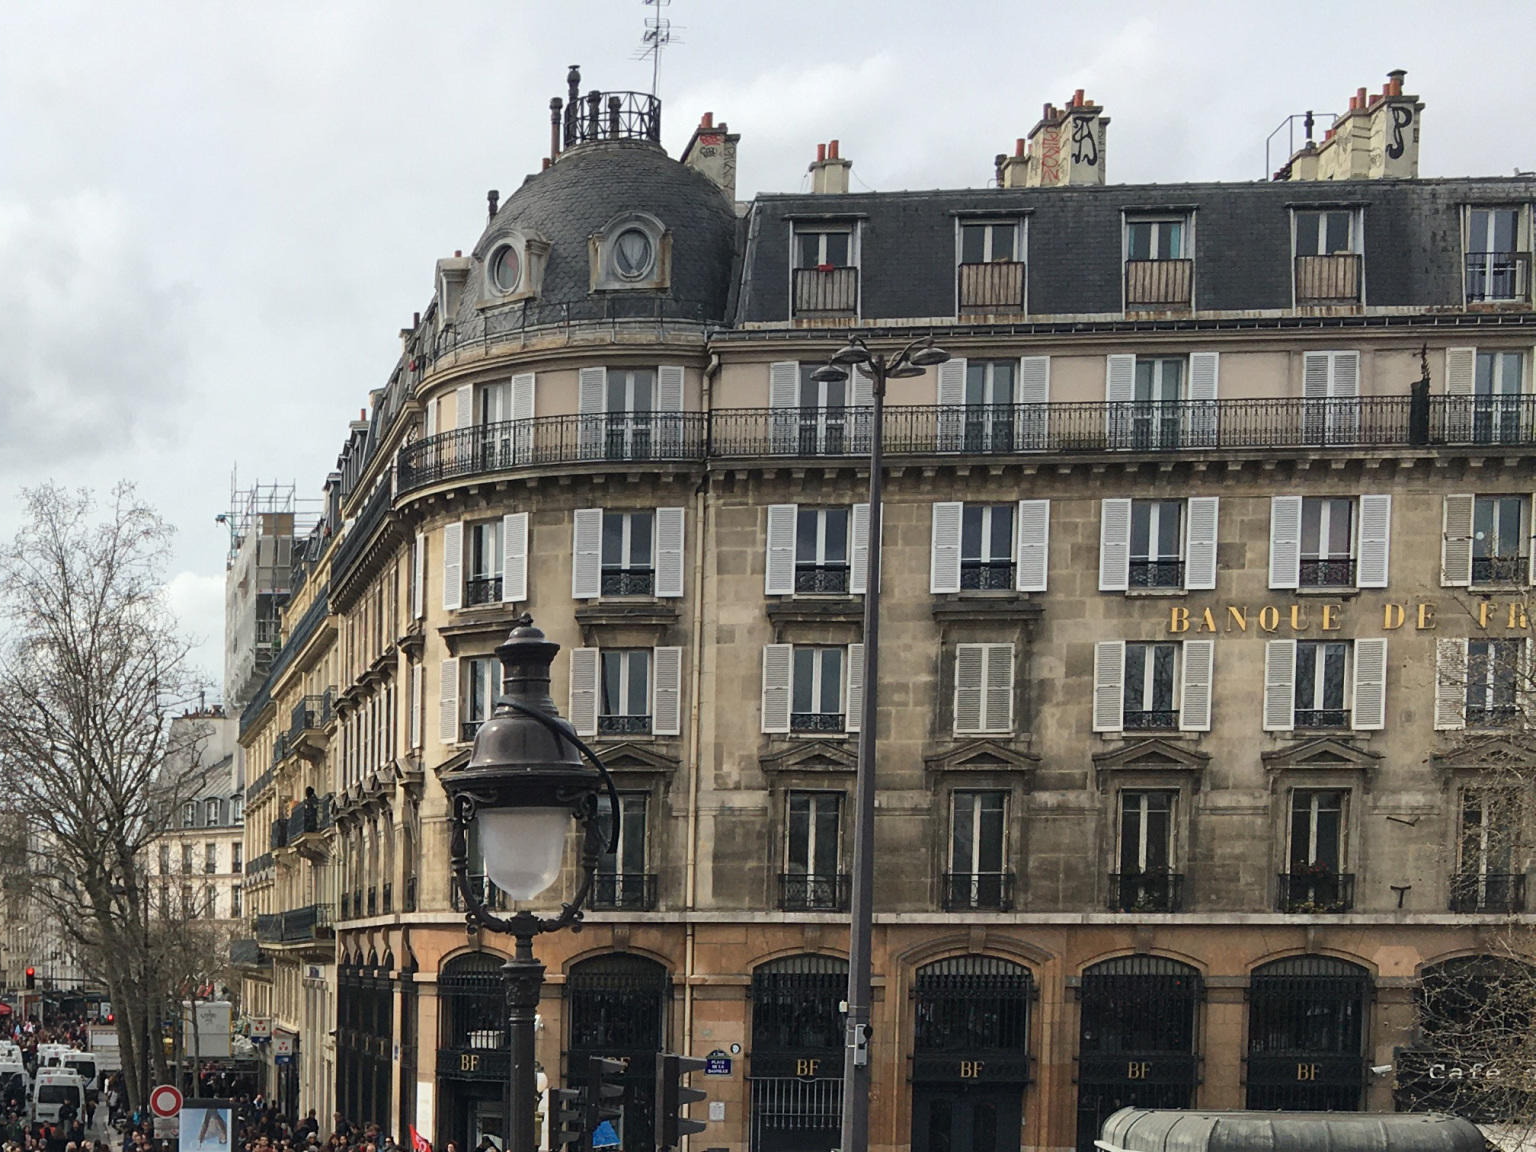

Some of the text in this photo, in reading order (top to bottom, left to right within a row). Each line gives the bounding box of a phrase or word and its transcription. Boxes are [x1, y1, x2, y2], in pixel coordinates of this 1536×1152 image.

[1169, 604, 1342, 633] BANQUE
[1382, 602, 1438, 631] DE
[460, 1054, 480, 1071] BF
[796, 1058, 821, 1076] BF
[960, 1060, 985, 1078] BF
[1128, 1062, 1152, 1080] BF
[1297, 1062, 1321, 1081] BF
